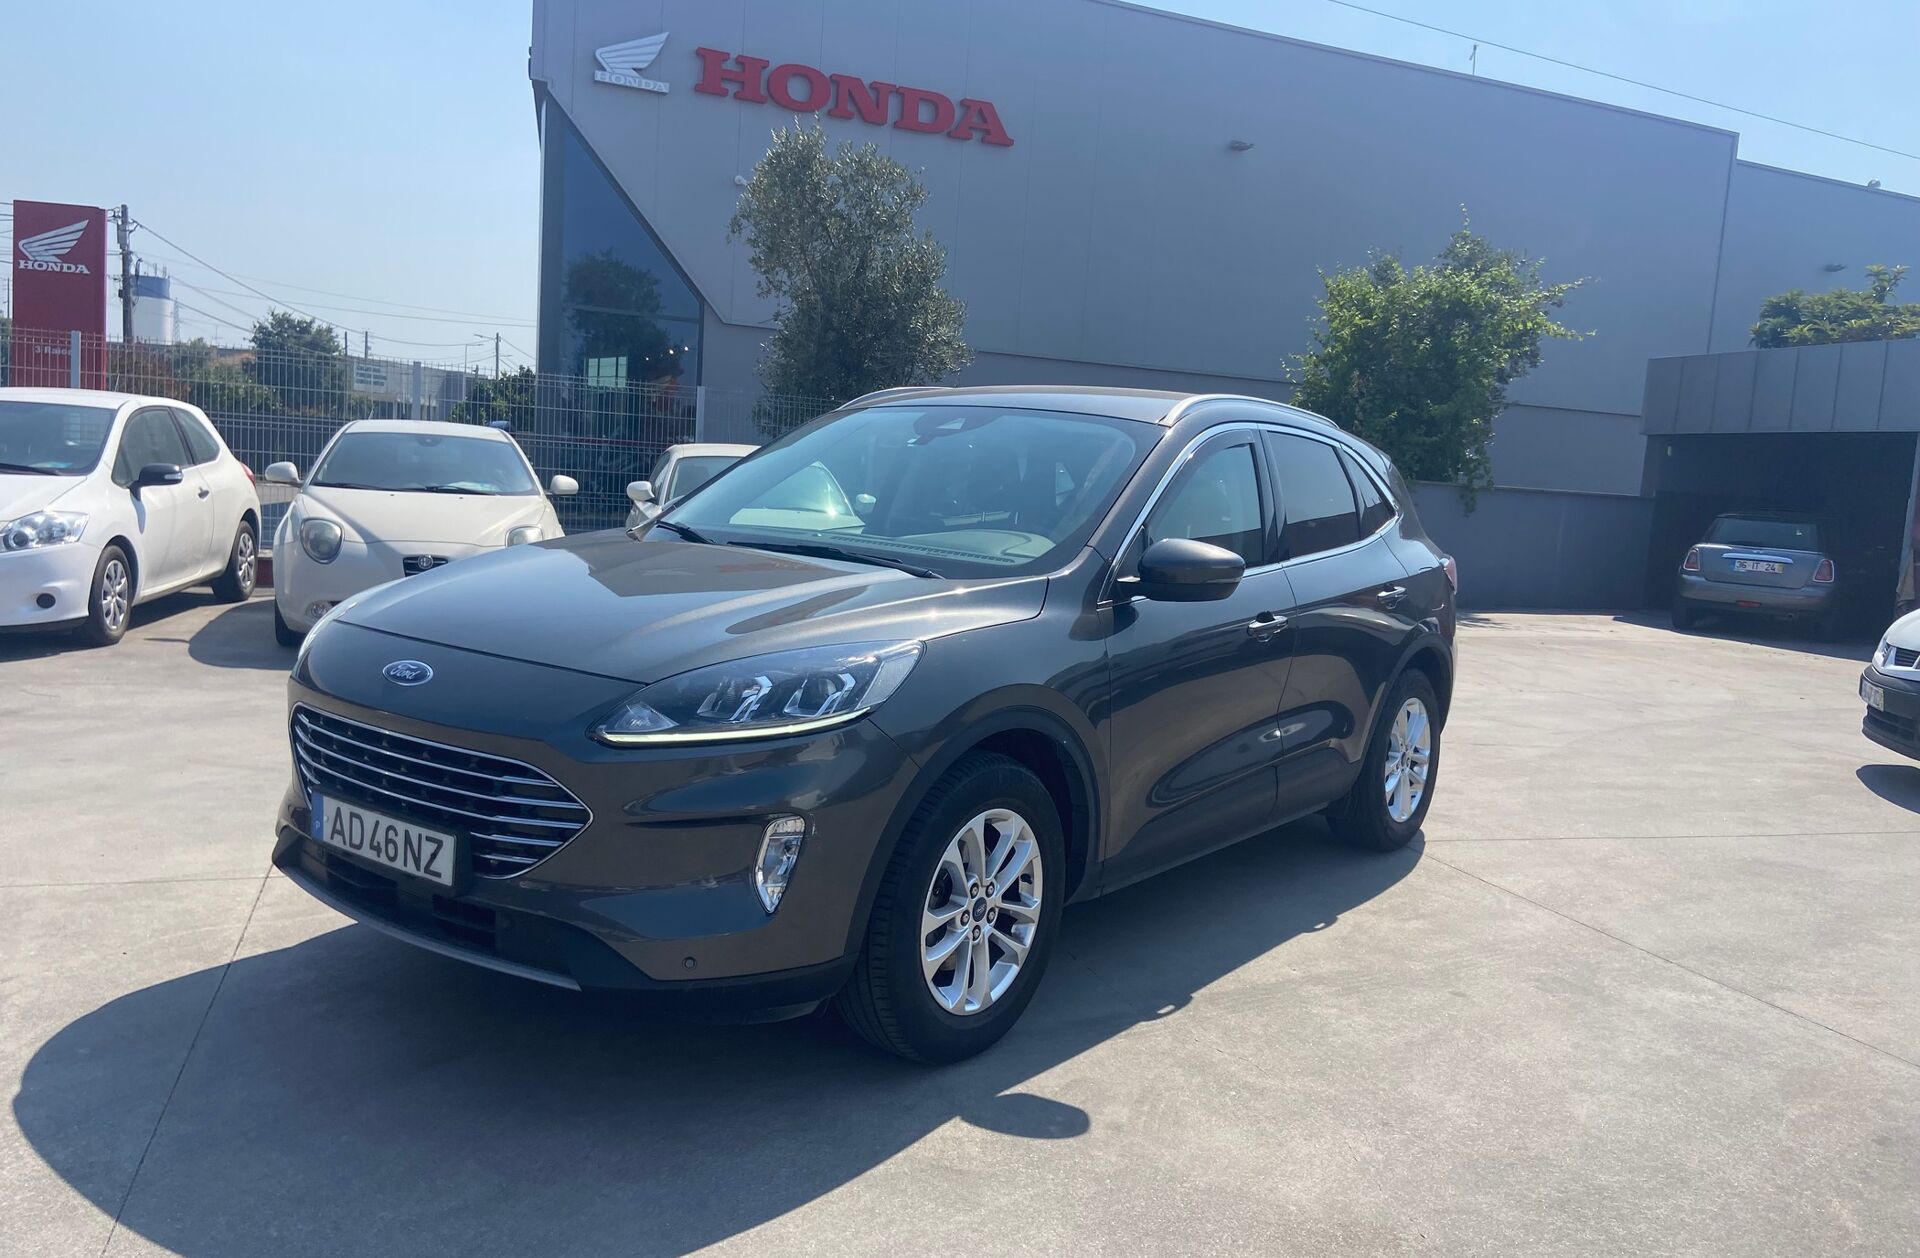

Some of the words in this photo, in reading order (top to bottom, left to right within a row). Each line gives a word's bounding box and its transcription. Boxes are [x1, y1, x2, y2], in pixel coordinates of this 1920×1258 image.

[594, 70, 669, 94] HONDA
[694, 46, 1014, 148] HONDA
[18, 259, 91, 275] HONDA
[390, 663, 421, 680] Ford
